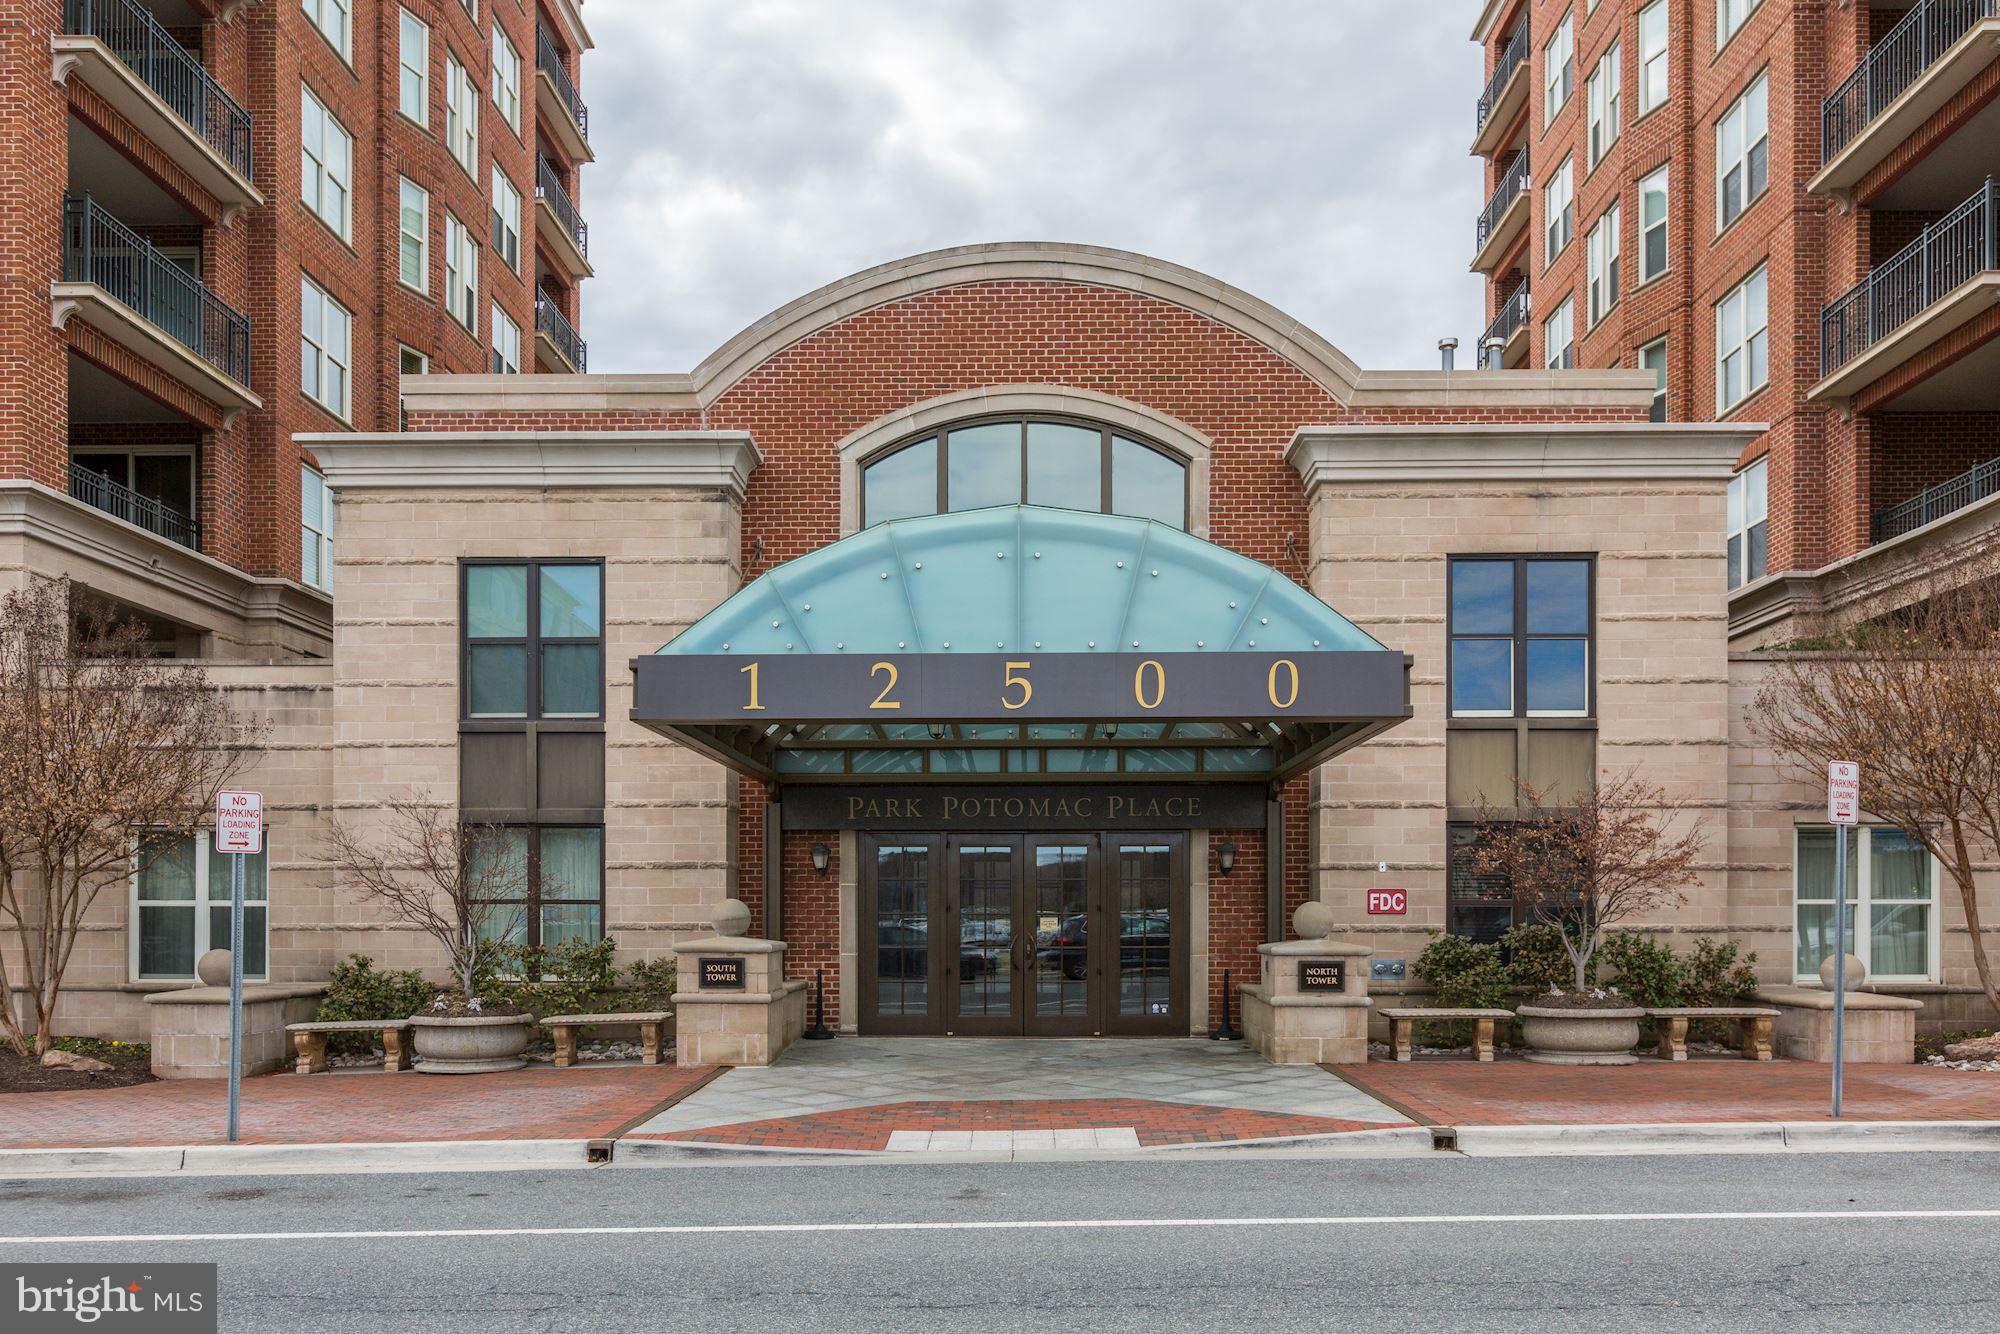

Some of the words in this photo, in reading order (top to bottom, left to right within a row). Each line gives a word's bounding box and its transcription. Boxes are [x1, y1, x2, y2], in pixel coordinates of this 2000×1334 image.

[1839, 767, 1848, 776] NO
[1831, 778, 1857, 788] PARKING
[1833, 791, 1854, 799] LOADING
[232, 797, 247, 806] NO
[847, 797, 923, 820] PARK
[942, 796, 1093, 820] POTOMAC
[1107, 796, 1202, 819] PLACE
[219, 808, 259, 818] PARKING
[222, 820, 256, 829] LOADING
[228, 831, 250, 839] ZONE
[1369, 893, 1405, 911] FDC
[706, 964, 736, 972] SOUTH
[1306, 967, 1338, 976] NORTH
[706, 973, 737, 981] TOWER
[1306, 976, 1338, 985] TOWER
